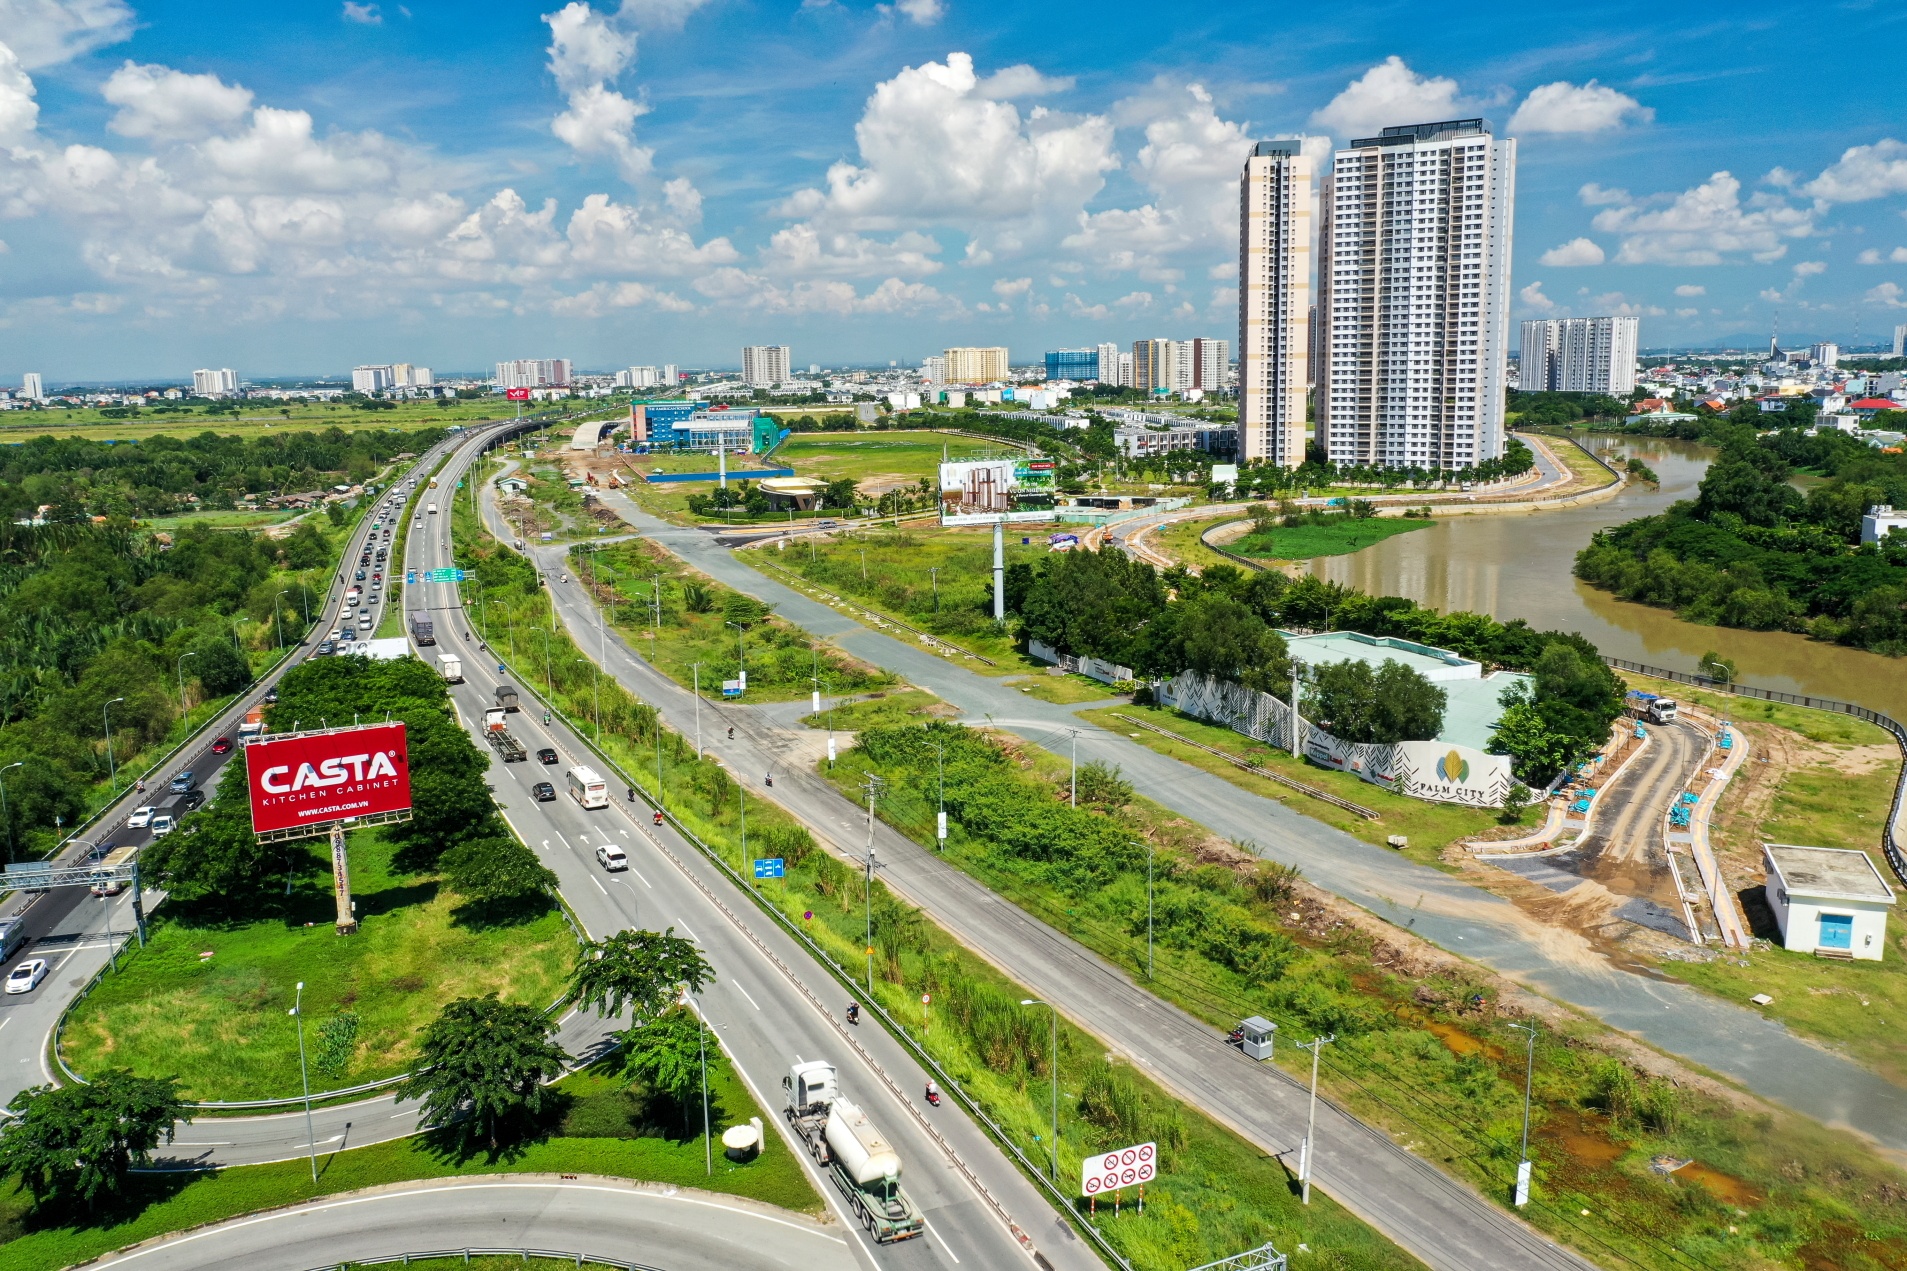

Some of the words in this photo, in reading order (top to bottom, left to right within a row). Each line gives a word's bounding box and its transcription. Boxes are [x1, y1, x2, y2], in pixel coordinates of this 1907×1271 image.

[262, 790, 327, 806] KITCHEN
[336, 779, 398, 795] CABINET
[1420, 782, 1450, 795] PALM
[1456, 787, 1485, 799] CITY
[298, 800, 369, 817] WWW.CASTA.COM.VN
